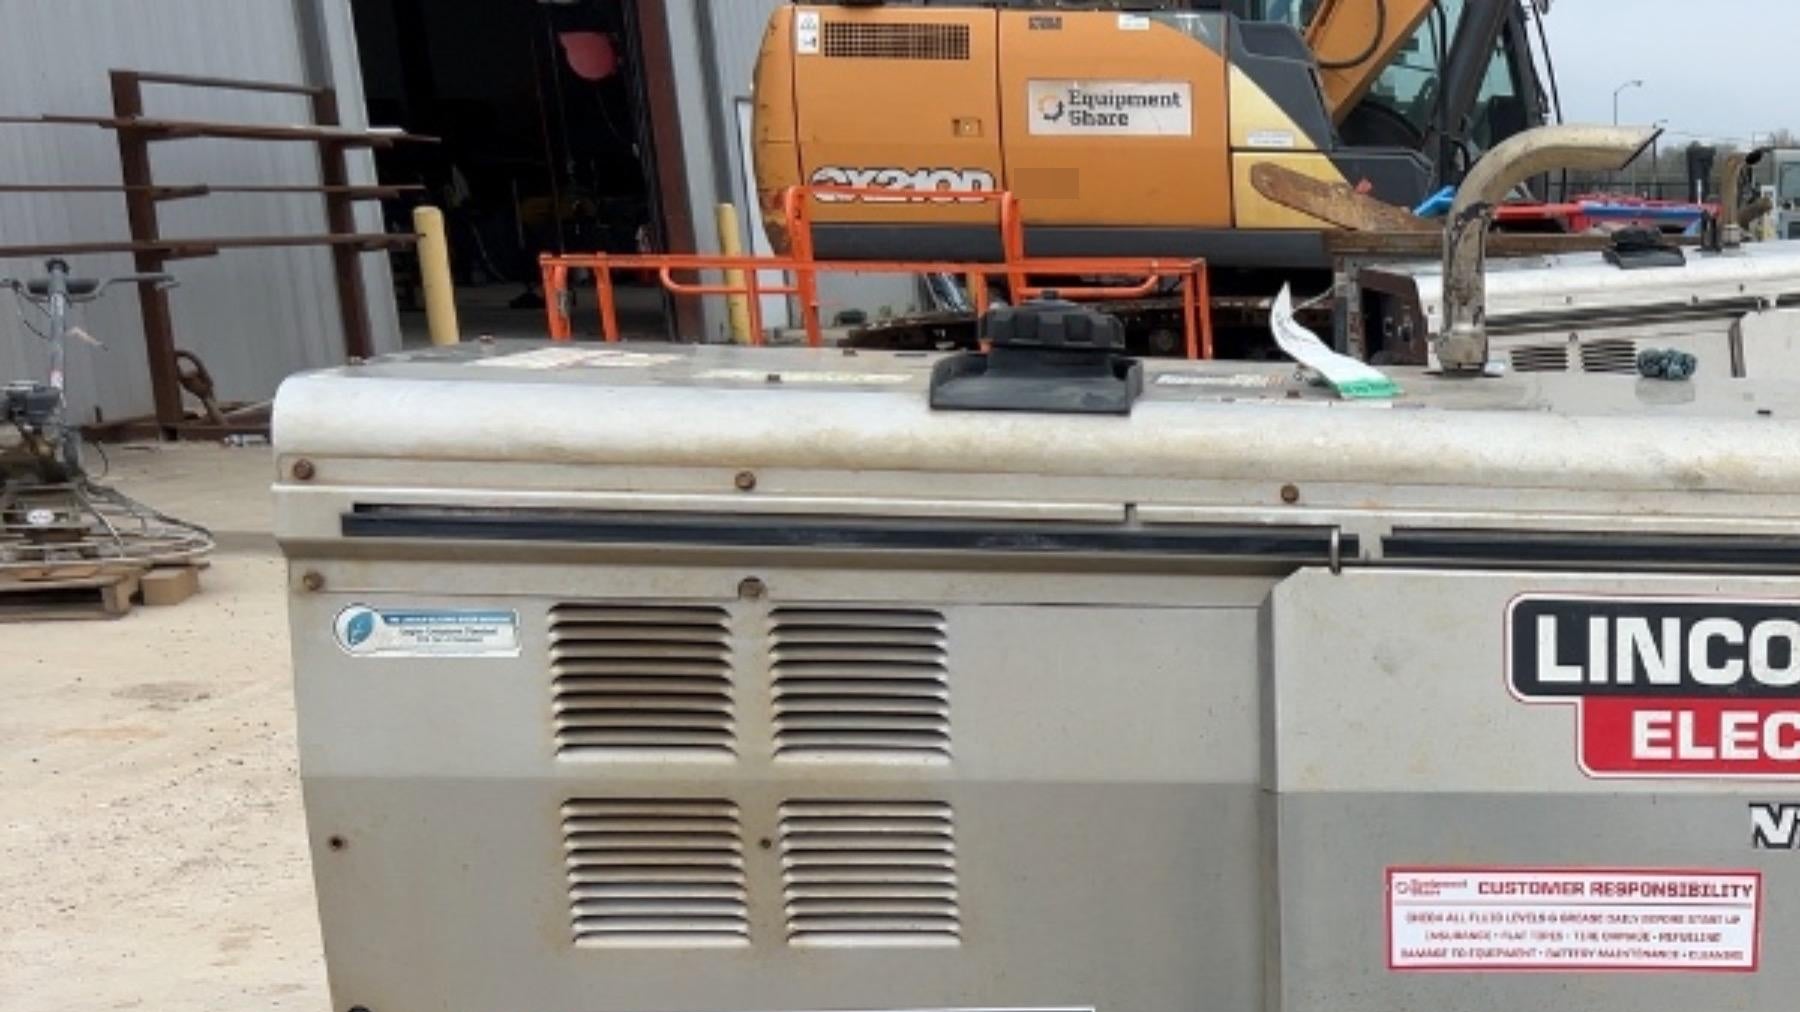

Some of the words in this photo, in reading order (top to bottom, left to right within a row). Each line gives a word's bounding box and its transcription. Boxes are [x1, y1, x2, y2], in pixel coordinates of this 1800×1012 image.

[1068, 89, 1182, 111] Equipment
[1069, 110, 1129, 127] Share
[1478, 880, 1585, 897] CUSTOMER
[1589, 881, 1754, 899] RESPONSIBILITY
